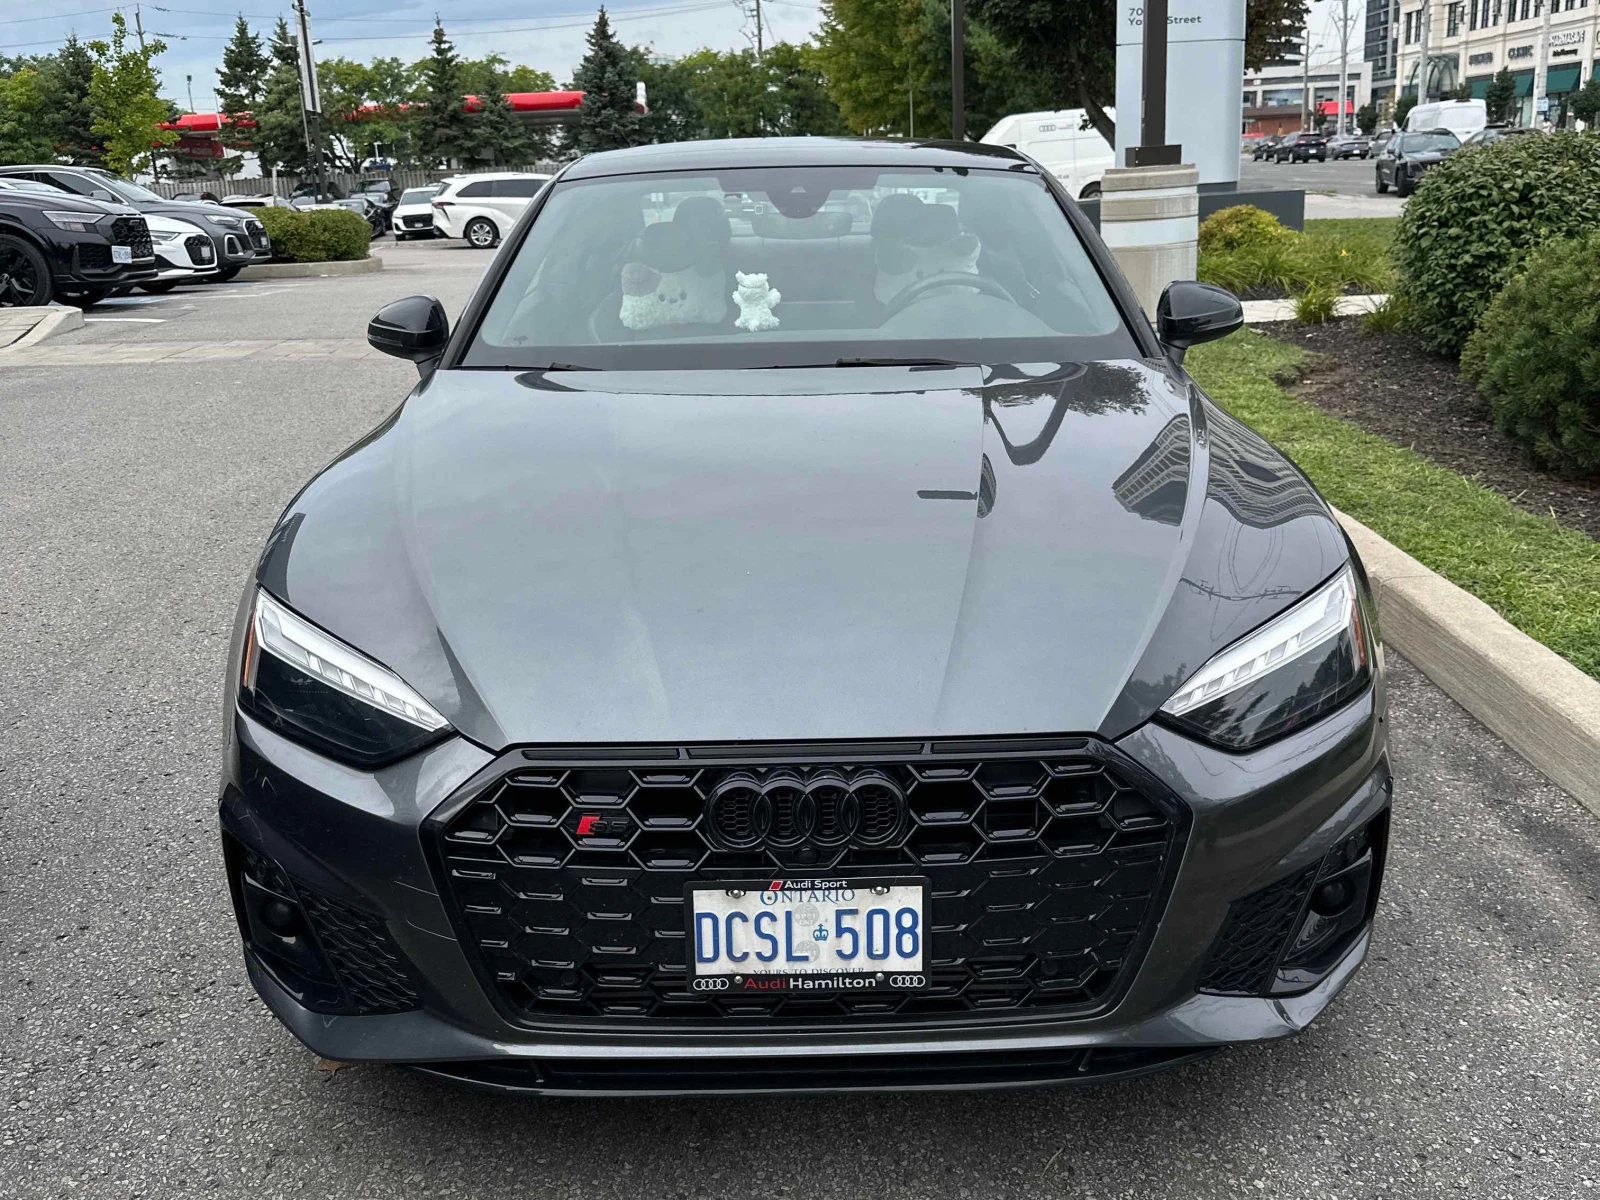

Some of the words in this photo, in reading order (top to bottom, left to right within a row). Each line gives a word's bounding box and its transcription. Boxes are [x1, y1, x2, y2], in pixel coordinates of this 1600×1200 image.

[1128, 8, 1144, 16] 70
[1167, 16, 1202, 24] Street
[784, 880, 811, 889] Audi
[814, 880, 848, 890] Sport
[760, 889, 855, 906] ONTARIO
[695, 911, 809, 963] DCSL
[835, 907, 919, 961] 508
[744, 978, 786, 989] Audi
[789, 976, 876, 989] Hamilton
